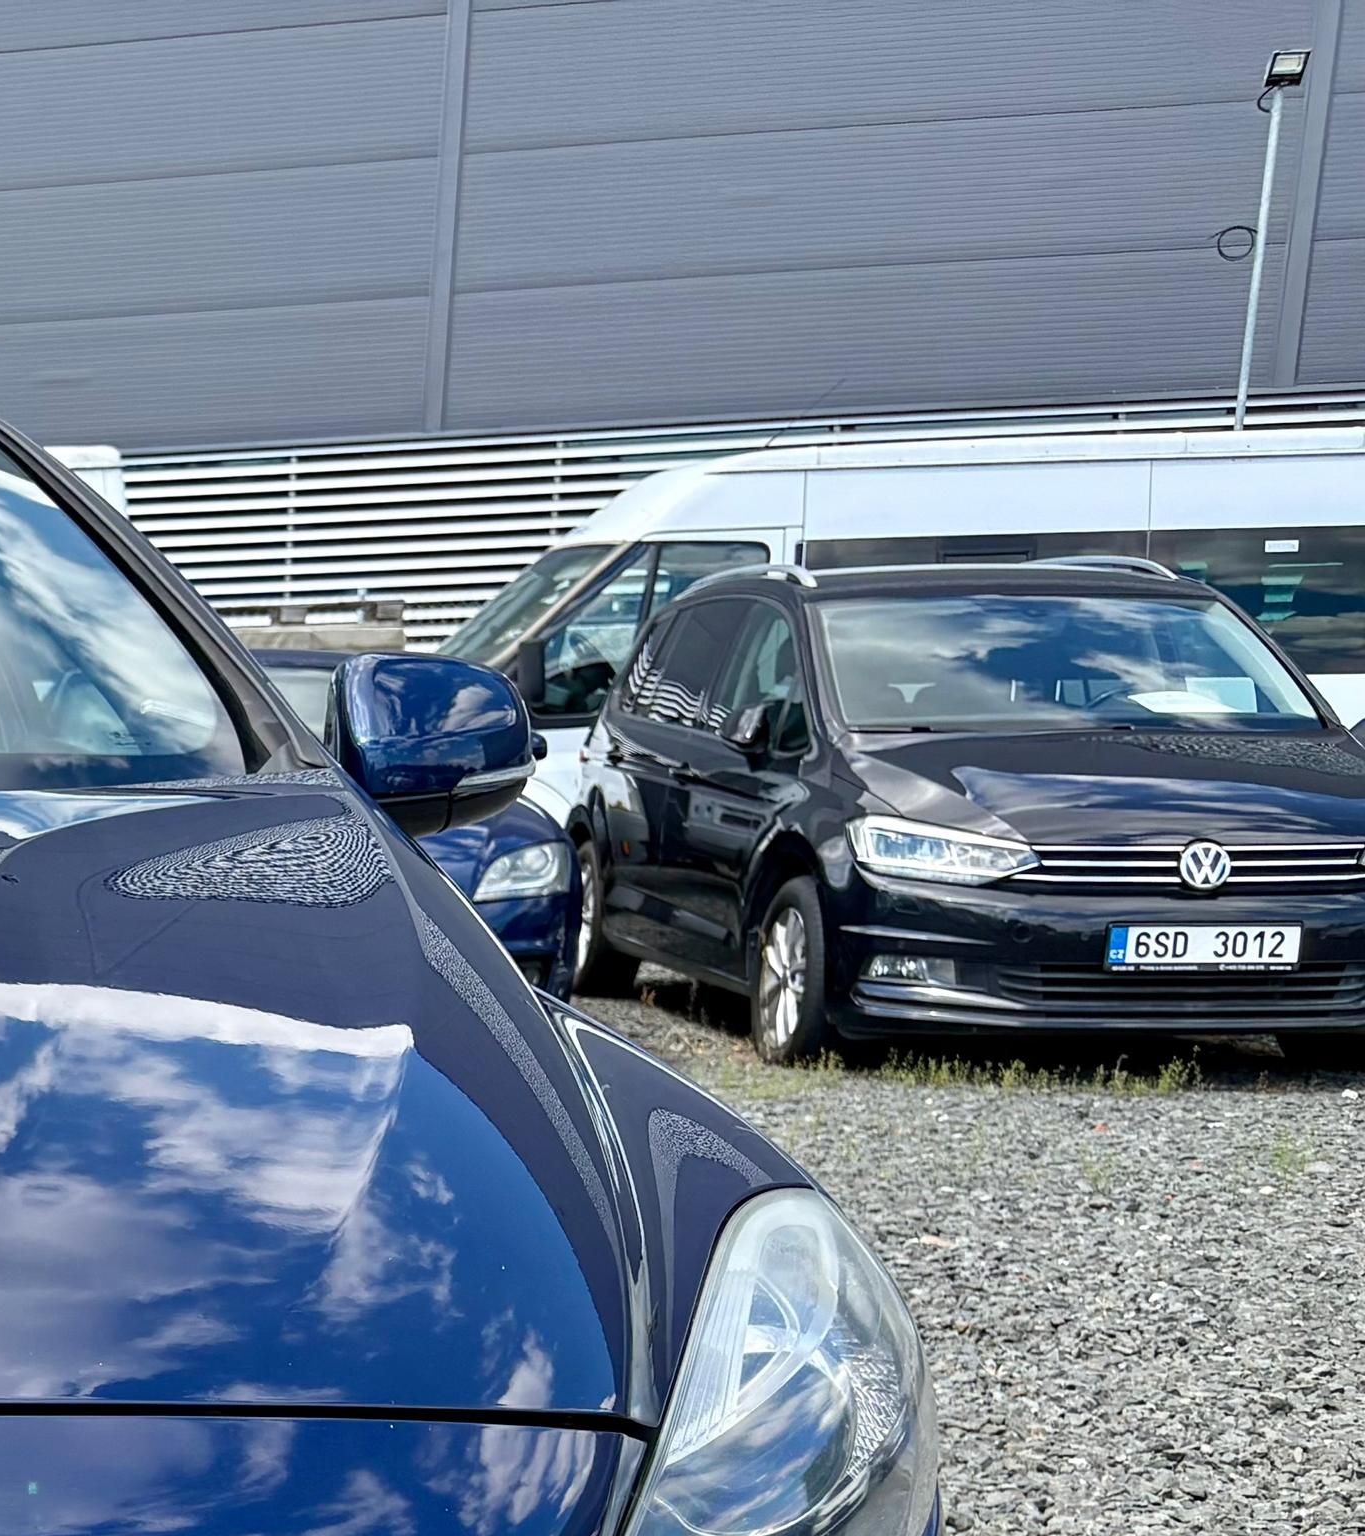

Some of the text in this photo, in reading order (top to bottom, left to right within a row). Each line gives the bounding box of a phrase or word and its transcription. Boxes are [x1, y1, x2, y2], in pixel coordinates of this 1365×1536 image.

[1134, 931, 1285, 958] 6SD 3012
[1109, 949, 1124, 960] CZ
